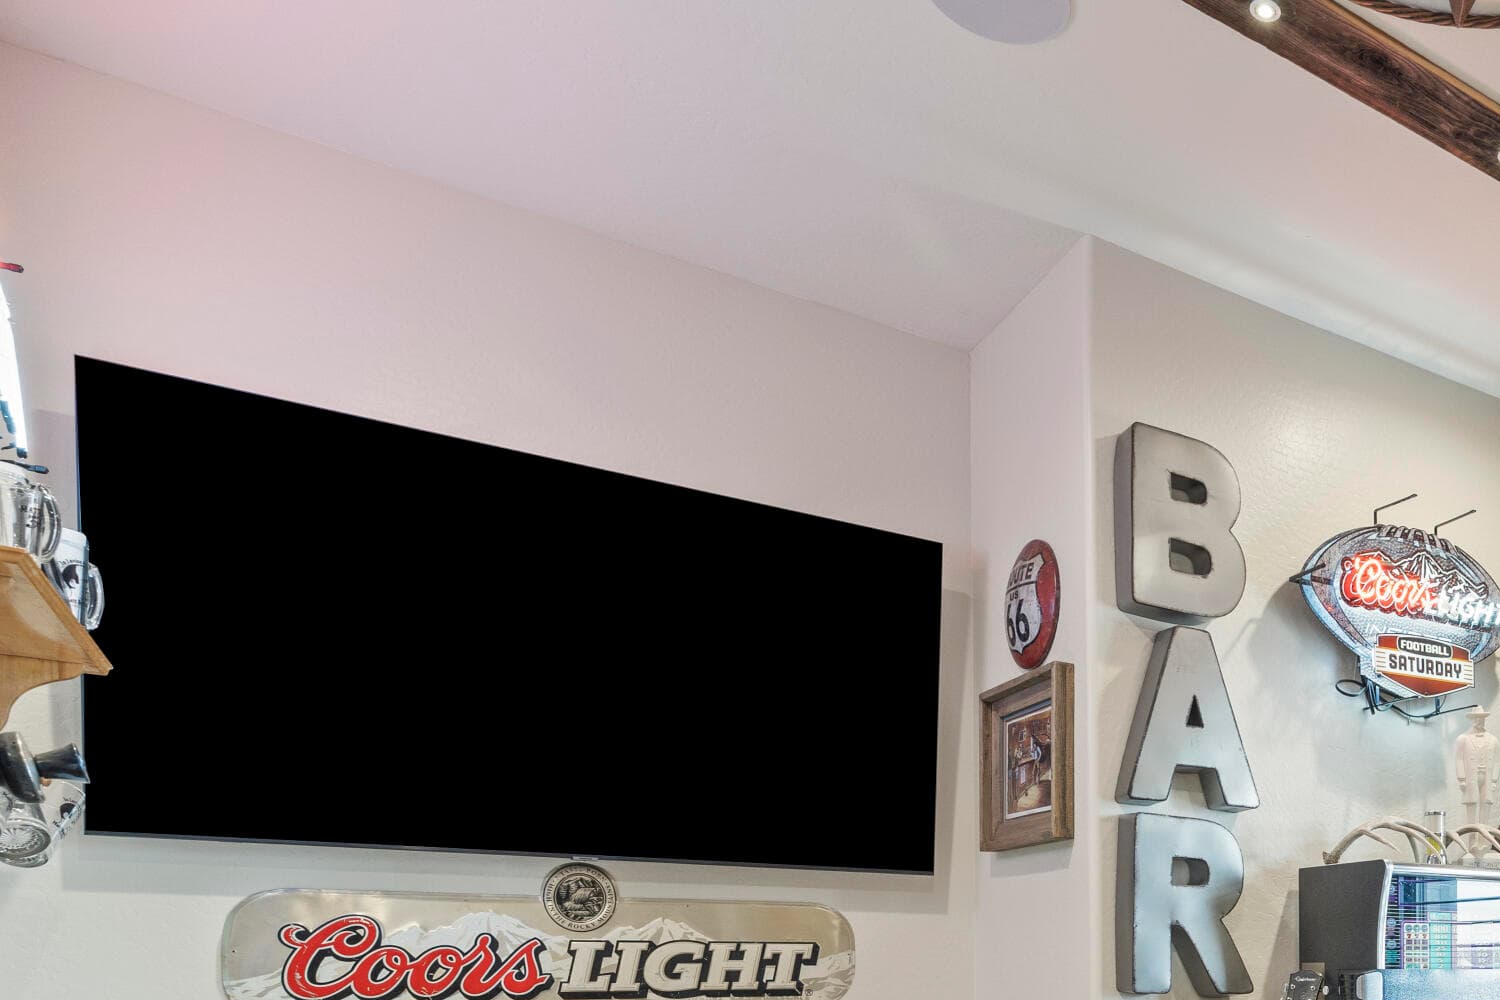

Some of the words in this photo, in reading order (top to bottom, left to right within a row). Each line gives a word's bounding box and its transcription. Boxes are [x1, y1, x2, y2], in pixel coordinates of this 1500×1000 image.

[1007, 598, 1030, 648] 66
[1400, 640, 1449, 656] FOOTBALL
[1388, 653, 1462, 679] SATURDAY
[1114, 421, 1260, 999] BAR
[279, 914, 554, 1000] Coors
[557, 940, 821, 999] LIGHT
